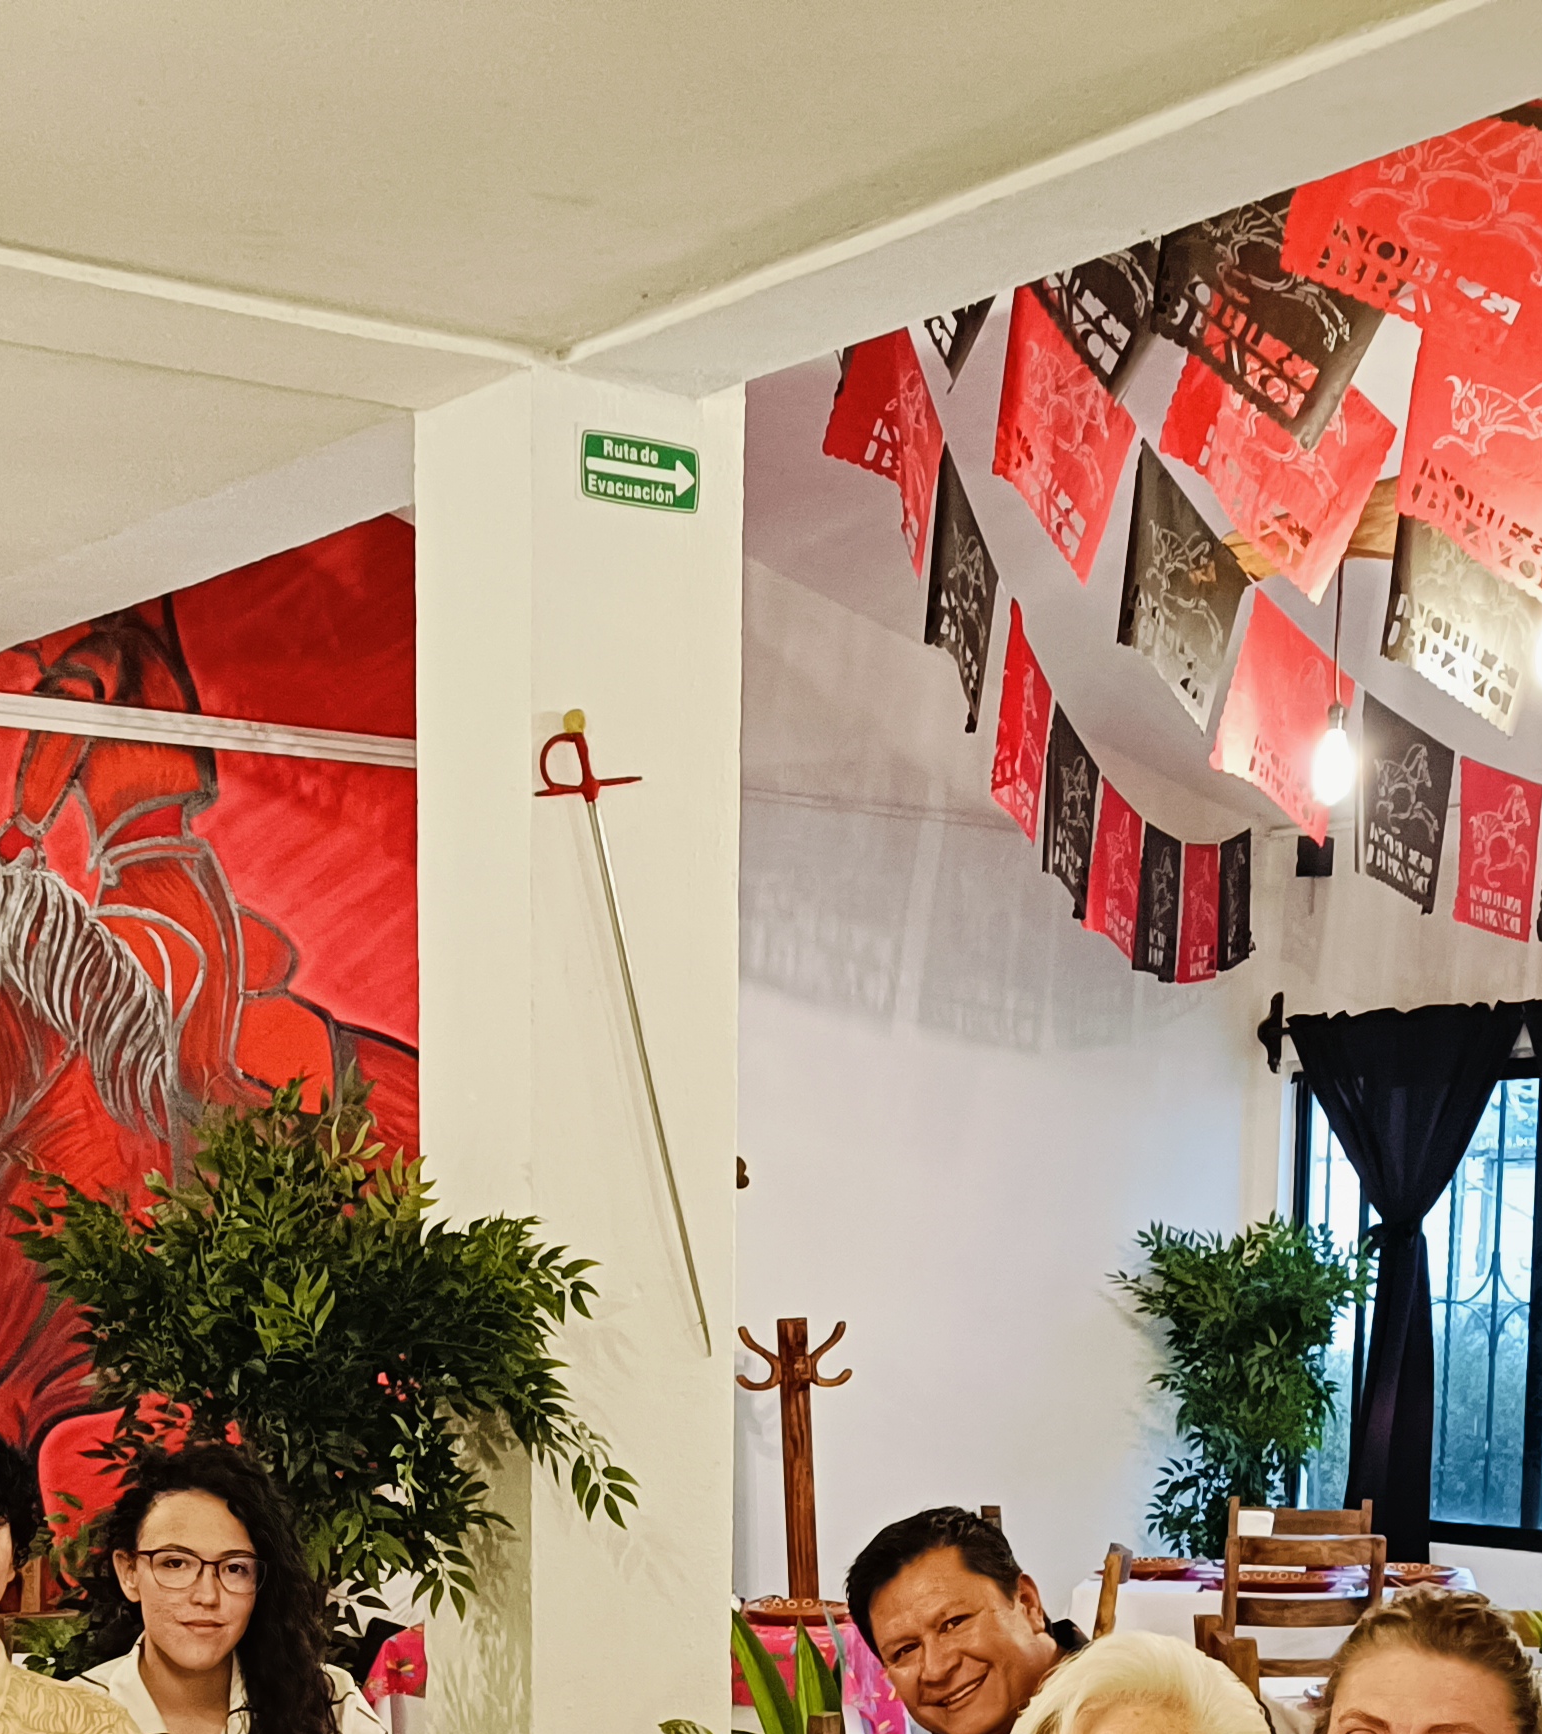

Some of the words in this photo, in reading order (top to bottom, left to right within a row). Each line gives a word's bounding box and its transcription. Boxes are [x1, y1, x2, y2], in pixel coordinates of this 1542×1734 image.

[603, 438, 638, 461] Ruta
[640, 446, 659, 465] de
[587, 473, 675, 505] Evacuación
